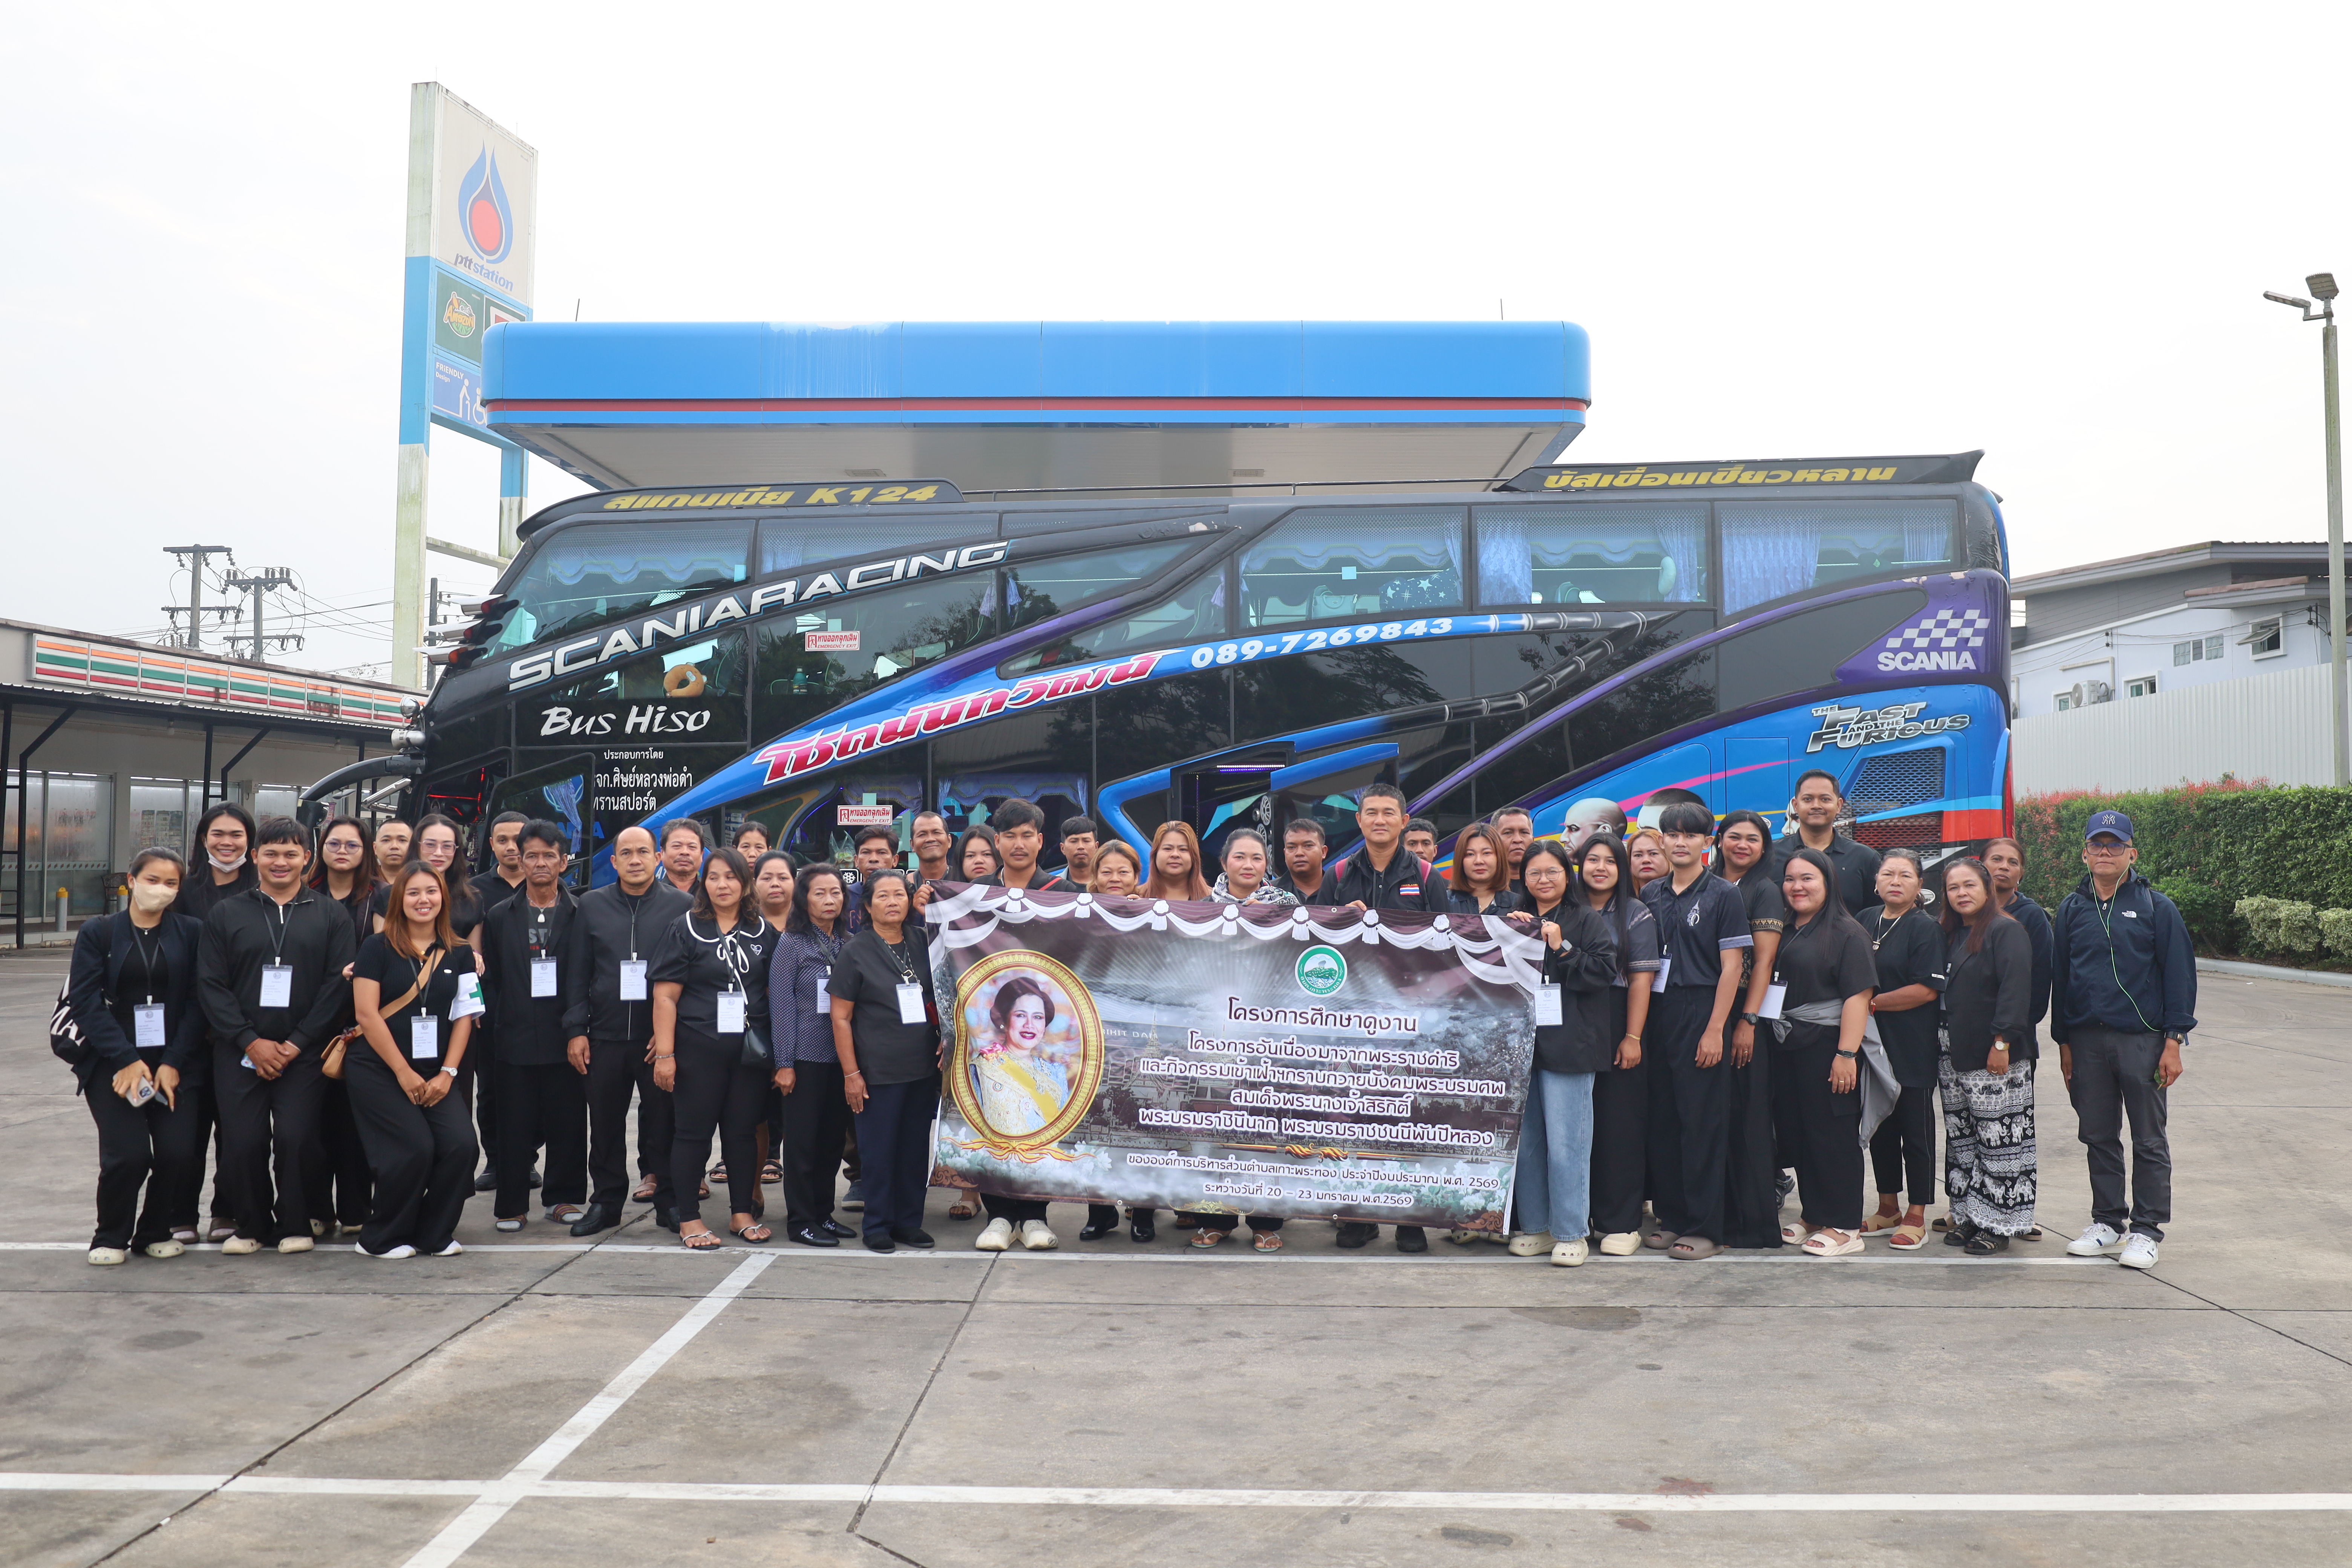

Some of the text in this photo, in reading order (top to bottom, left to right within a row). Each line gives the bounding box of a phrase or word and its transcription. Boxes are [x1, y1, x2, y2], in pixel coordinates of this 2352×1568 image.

[454, 253, 513, 292] ptt station
[436, 371, 450, 383] Design
[804, 485, 939, 504] K124
[817, 633, 858, 644] ทางออกฉุกเฉิน
[1191, 617, 1453, 669] 089-7269843
[1877, 651, 1977, 671] SCANIA
[540, 704, 711, 737] Bus Hiso
[1811, 704, 1839, 716] THE
[1822, 701, 1927, 730] FAST
[1806, 714, 1971, 753] FURIOUS
[1848, 725, 1874, 733] AND
[603, 747, 664, 760] ประกอบการโดย
[594, 765, 693, 788] จก.ศิษย์หลวงพ่อดำ
[850, 808, 890, 819] ทางออกฉุกเฉิน
[1228, 996, 1416, 1035] โครงการศึกษาดูงาน
[1190, 1030, 1458, 1067] โครงการอันเนื่องมาจากพระราชดำริ
[1233, 1088, 1411, 1115] สมเด็จพระนางเจ้าสิริกิติ์
[1141, 1110, 1493, 1144] พระบรมราชินีนาถ พระบรมราชชนนีพันปีหลวง
[1129, 1153, 1499, 1188] ขององค์การบริหารส่วนตำบลเกาะพระทอง ประจำปีงบประมาณ พ.ศ. 2569
[1205, 1180, 1263, 1196] ระหว่างวันที่
[1267, 1187, 1282, 1197] 20
[1298, 1190, 1312, 1199] 23
[1316, 1192, 1358, 1202] มกราคม
[1363, 1194, 1412, 1205] พ.ศ.2569
